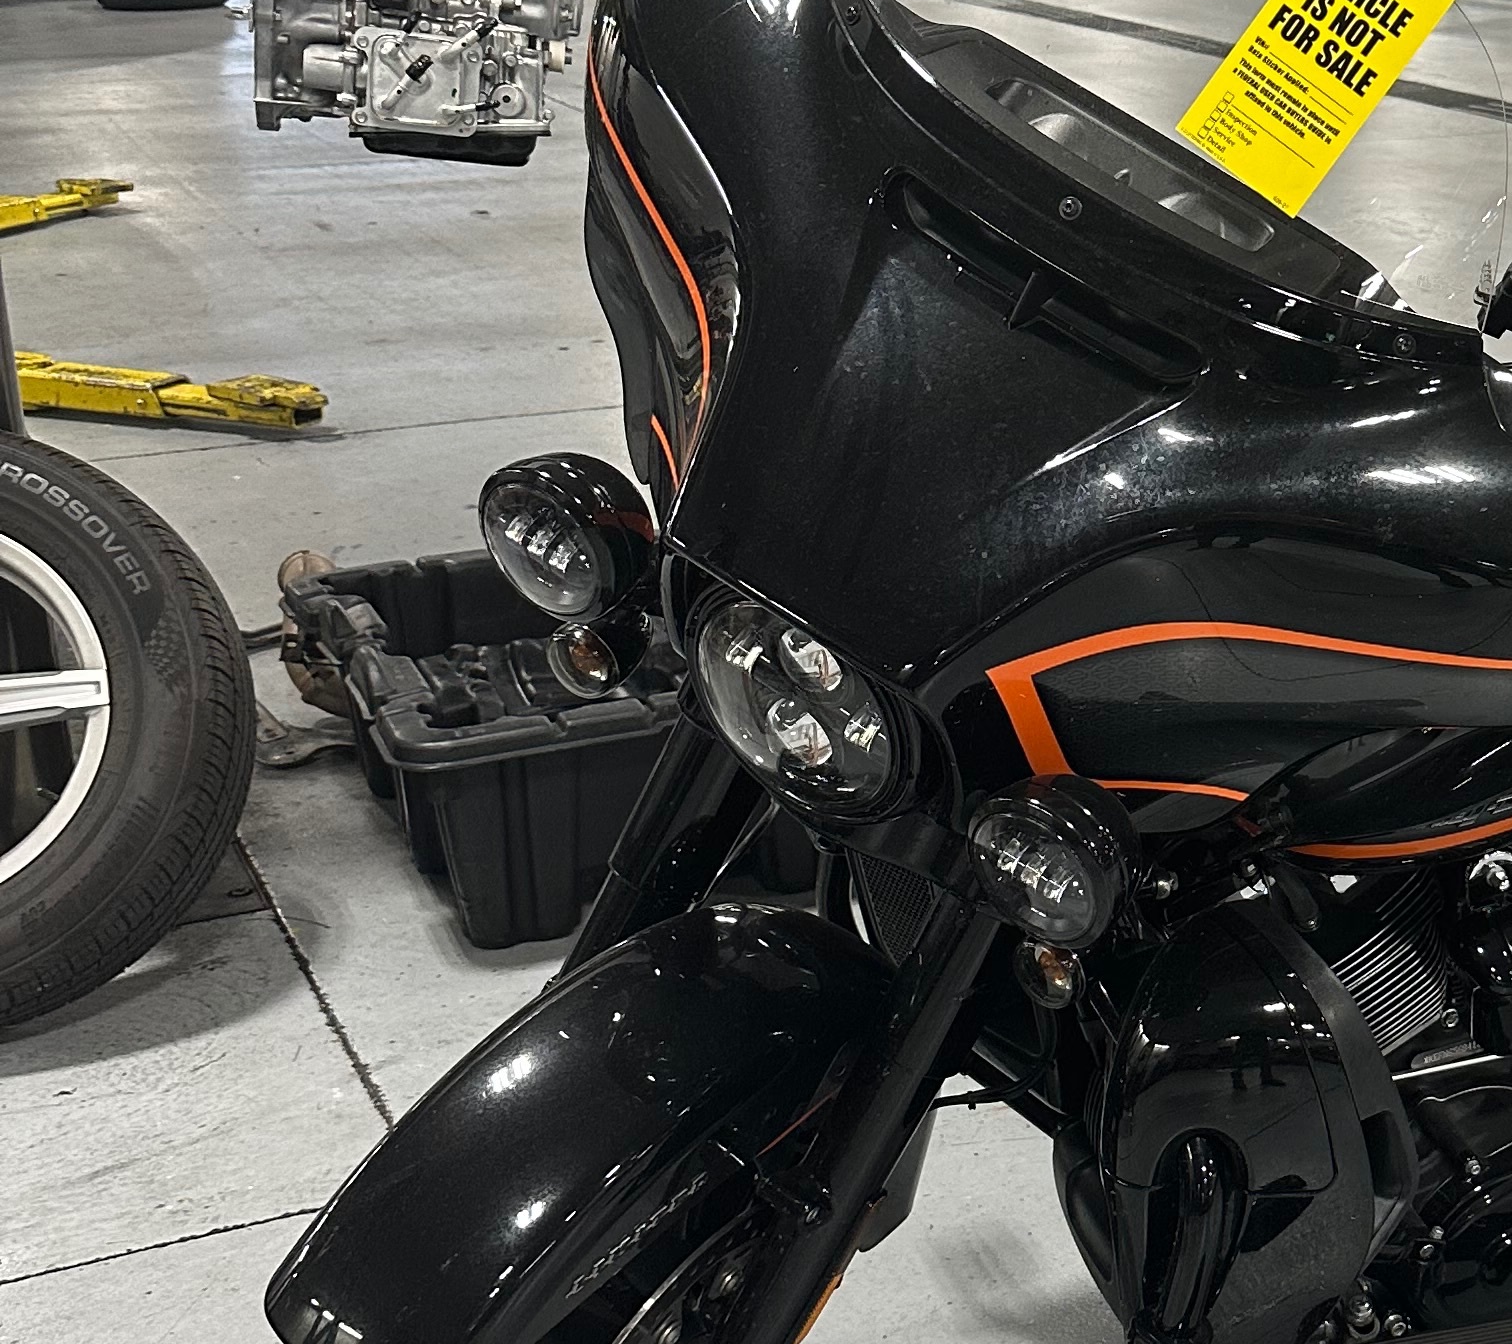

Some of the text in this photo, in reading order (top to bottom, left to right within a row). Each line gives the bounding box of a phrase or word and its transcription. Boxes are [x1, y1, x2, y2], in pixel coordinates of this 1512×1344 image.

[1267, 3, 1378, 97] FOR SALE
[1327, 5, 1386, 57] NOT
[1206, 135, 1227, 154] Detail
[1214, 126, 1236, 147] Service
[1219, 117, 1236, 134] Body
[1237, 130, 1253, 147] Shop
[0, 461, 151, 595] ROSSOVER
